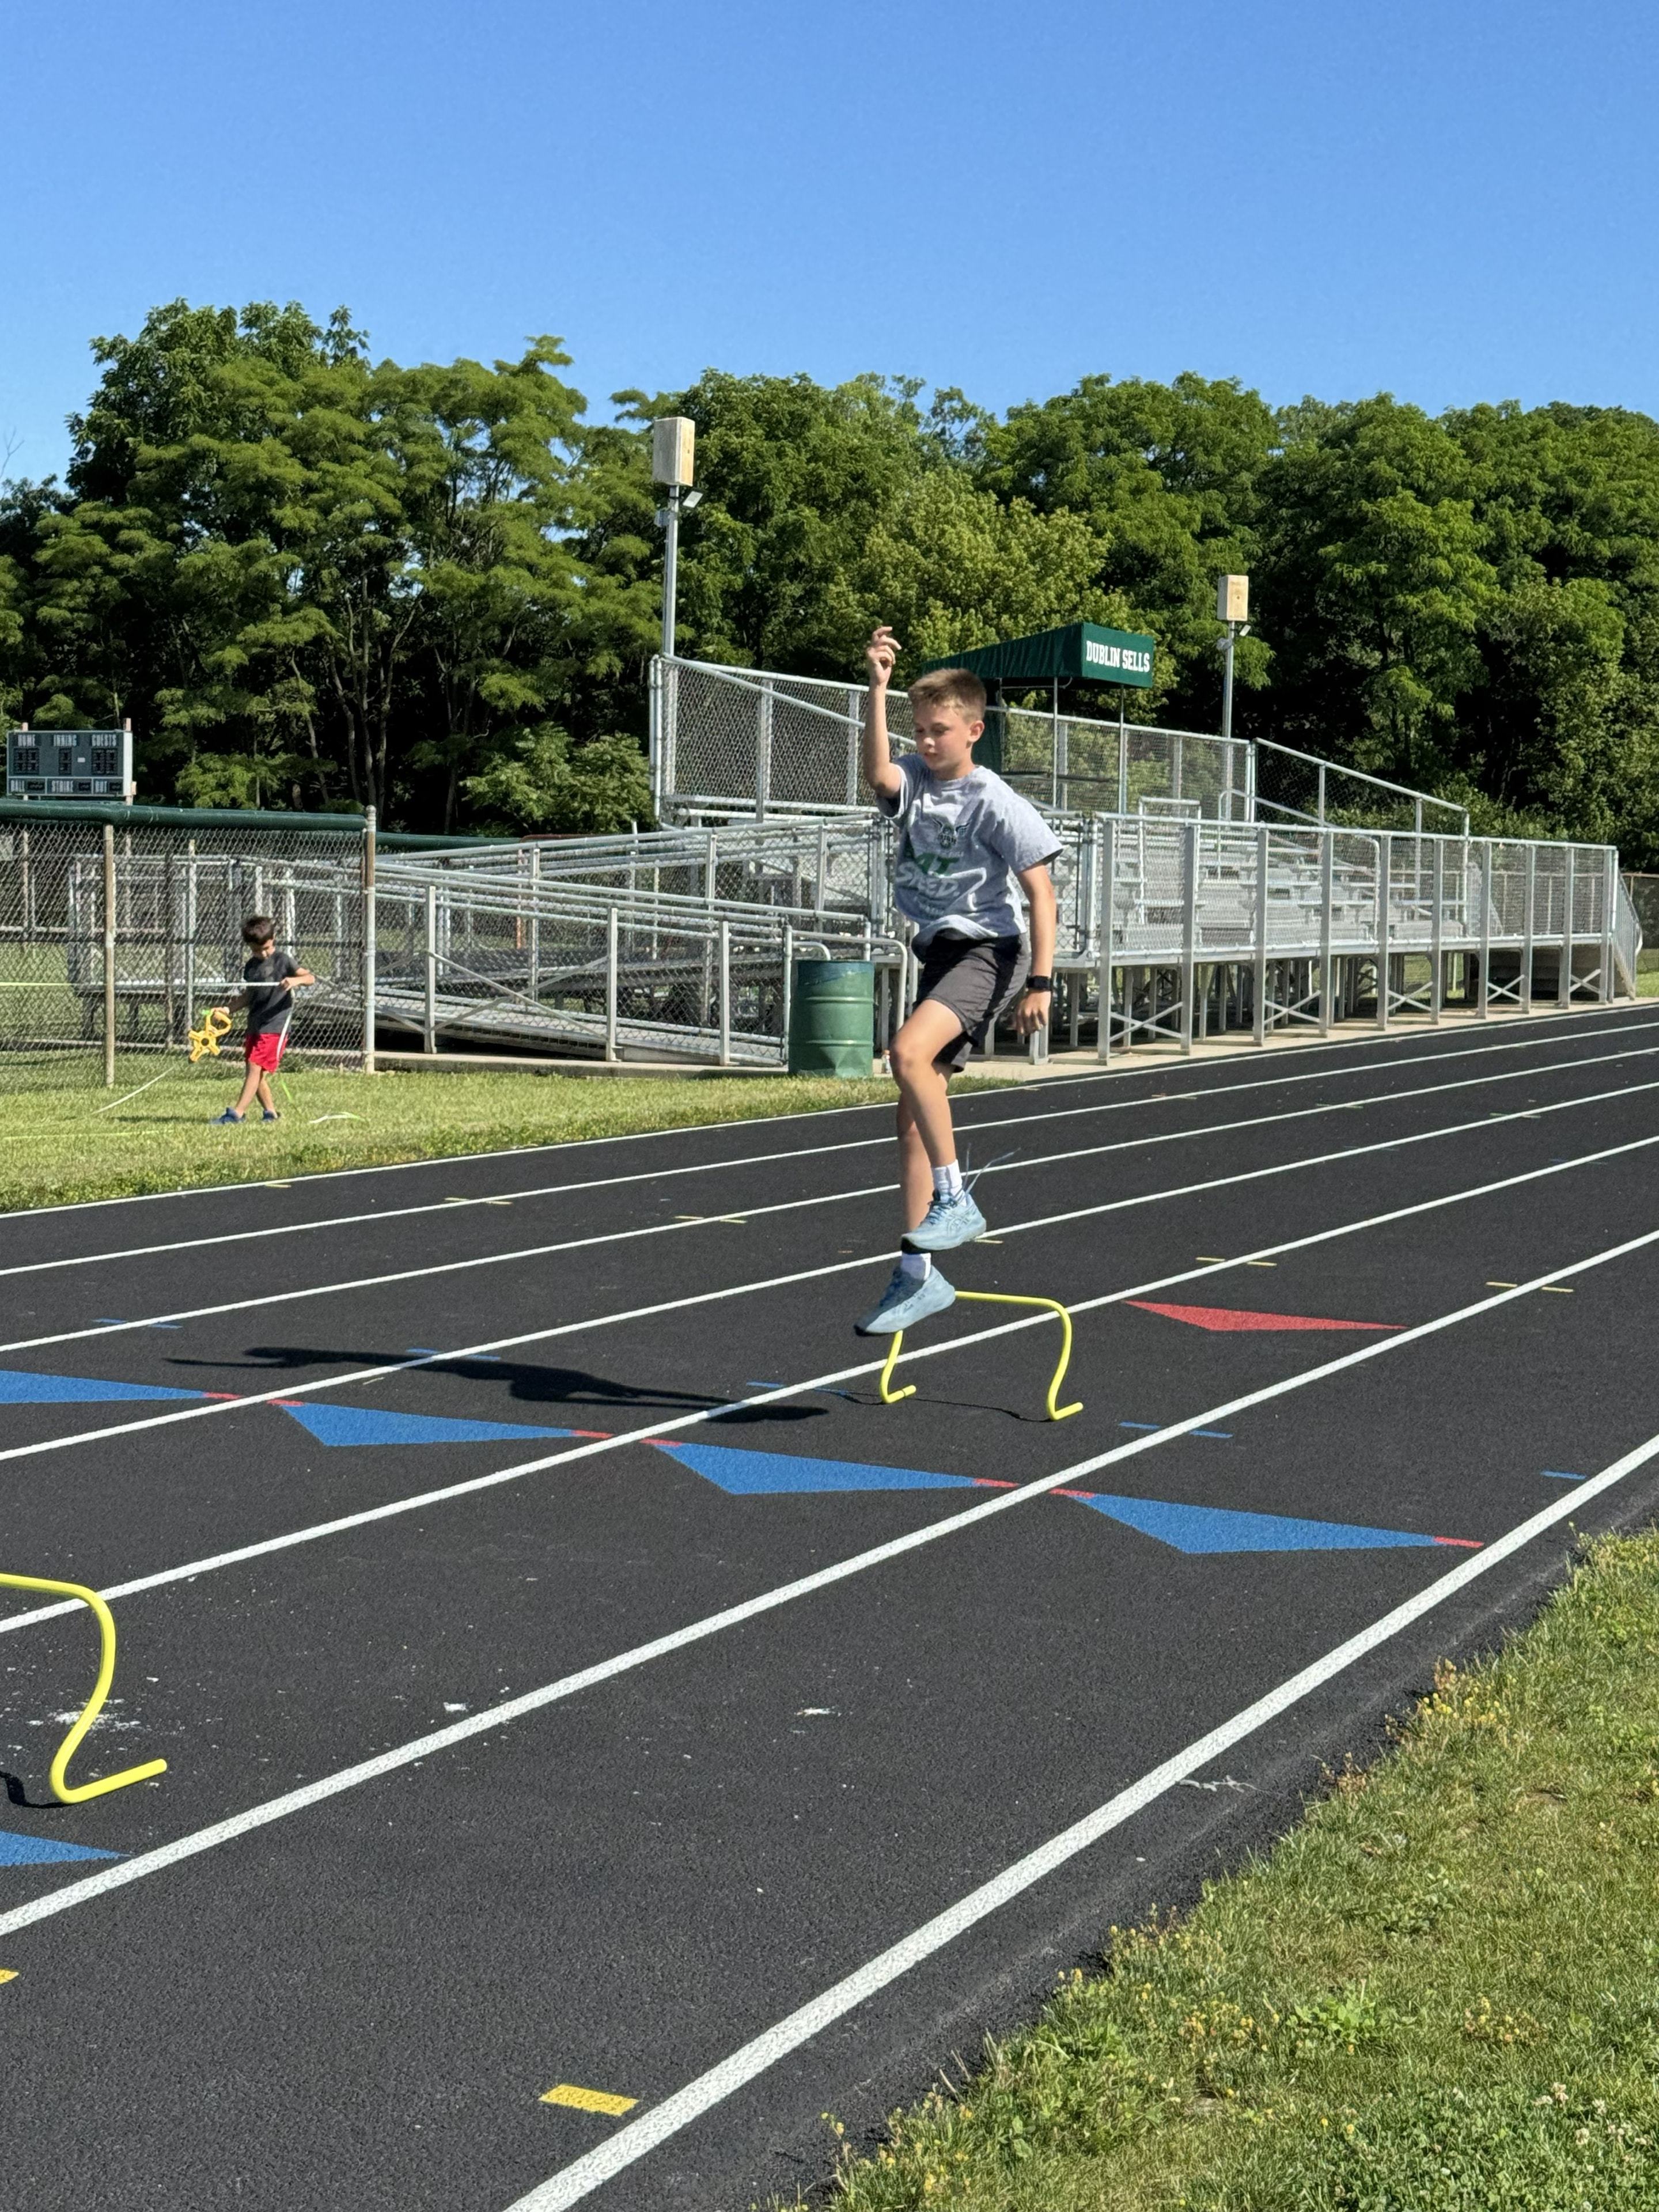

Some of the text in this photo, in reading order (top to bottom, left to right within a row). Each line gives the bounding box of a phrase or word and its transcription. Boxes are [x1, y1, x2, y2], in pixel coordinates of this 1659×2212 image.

[1086, 640, 1150, 673] DUBLIN SELLS
[92, 734, 116, 747] GUESTS
[10, 779, 25, 793] BALL
[51, 780, 74, 793] STRIKE
[95, 781, 107, 793] OUT
